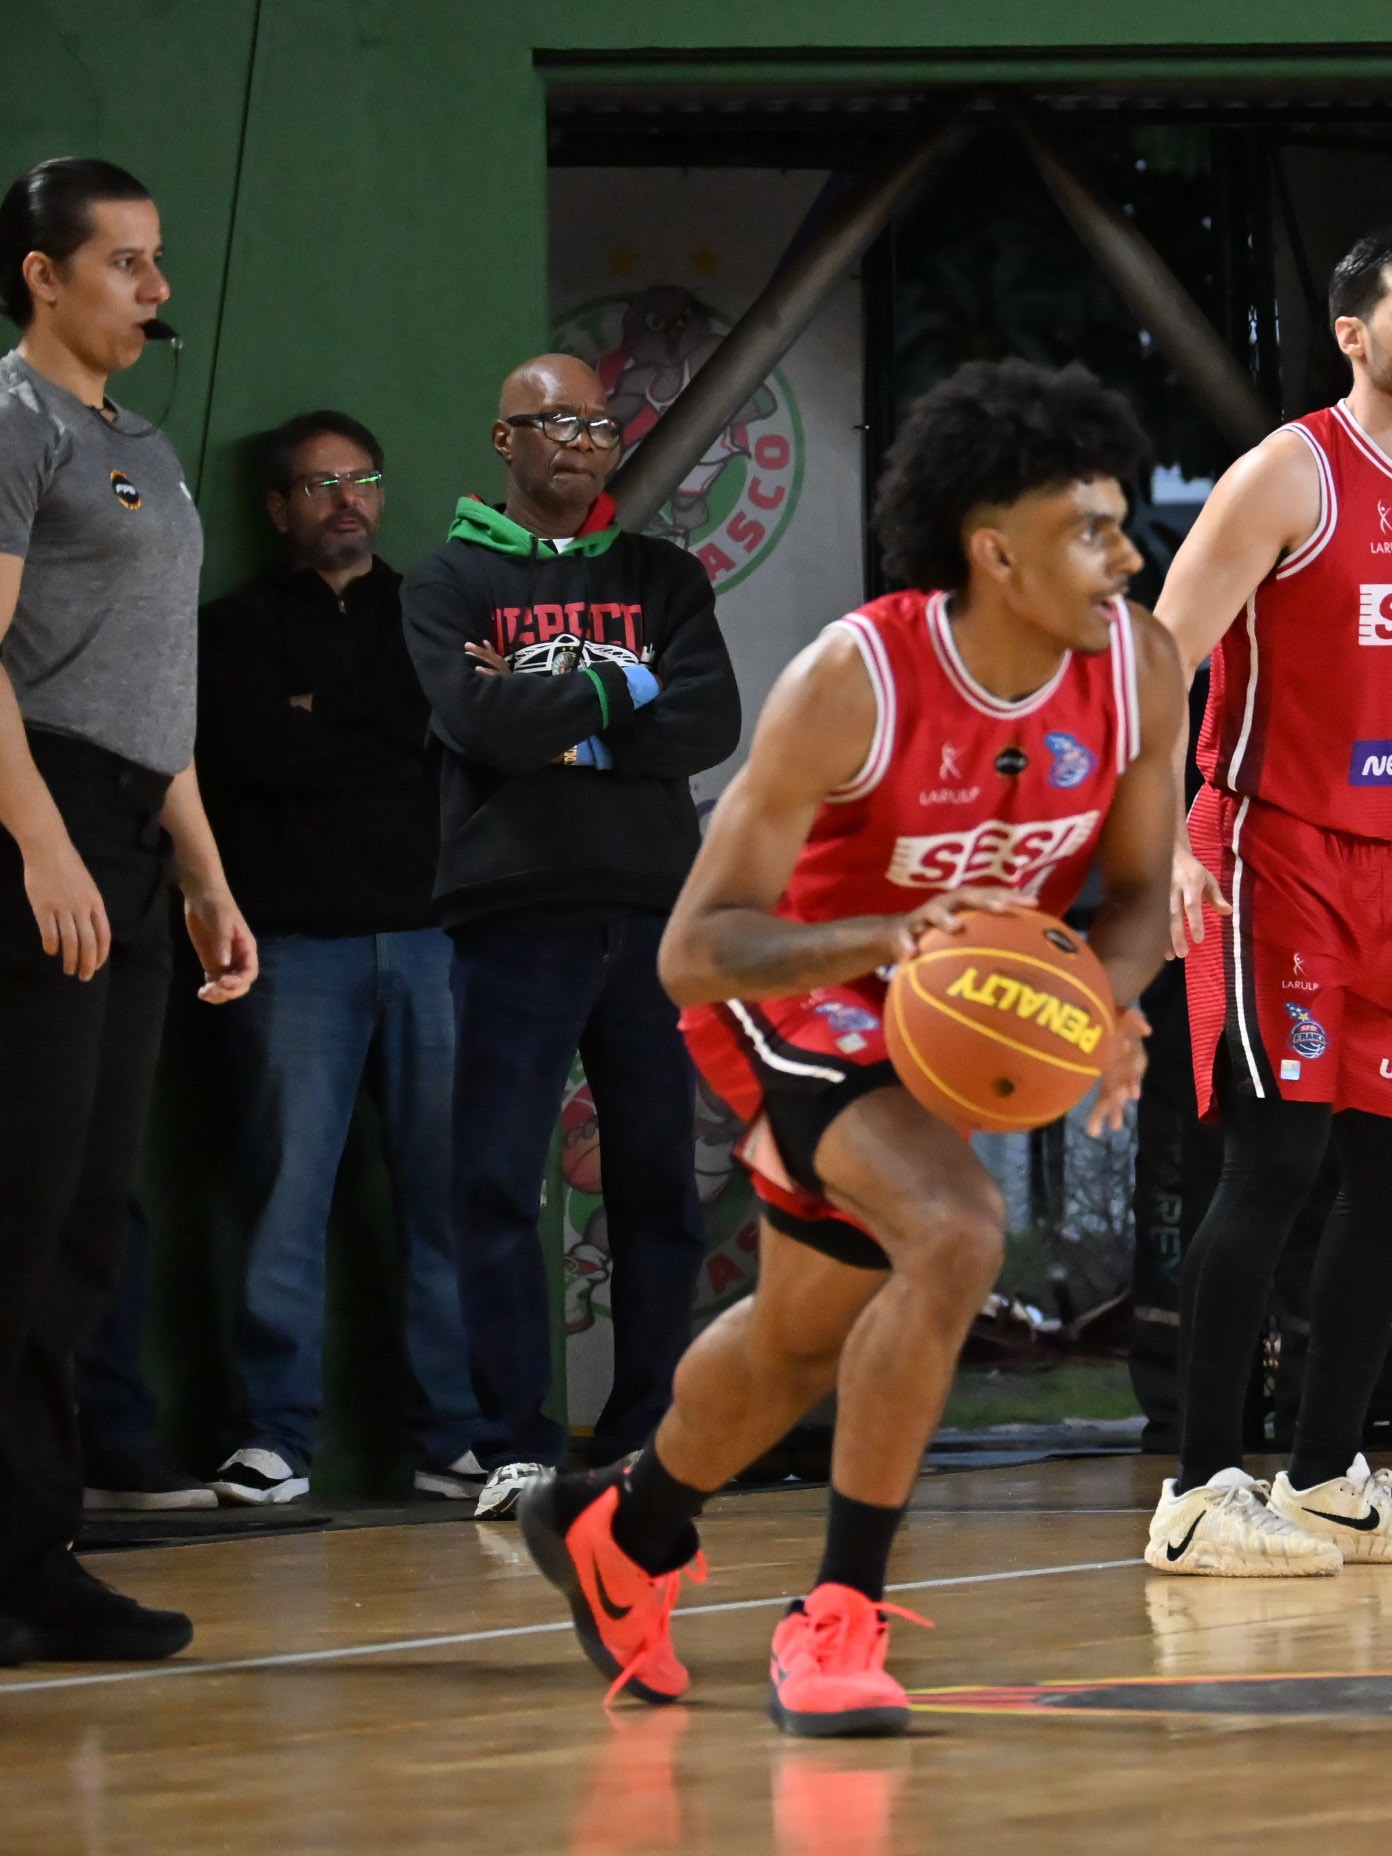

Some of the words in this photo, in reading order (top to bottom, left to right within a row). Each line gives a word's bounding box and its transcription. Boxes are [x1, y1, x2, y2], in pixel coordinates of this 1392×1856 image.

[909, 823, 1077, 890] SESI
[946, 966, 1103, 1054] PENALTY
[1281, 980, 1319, 991] LARULP
